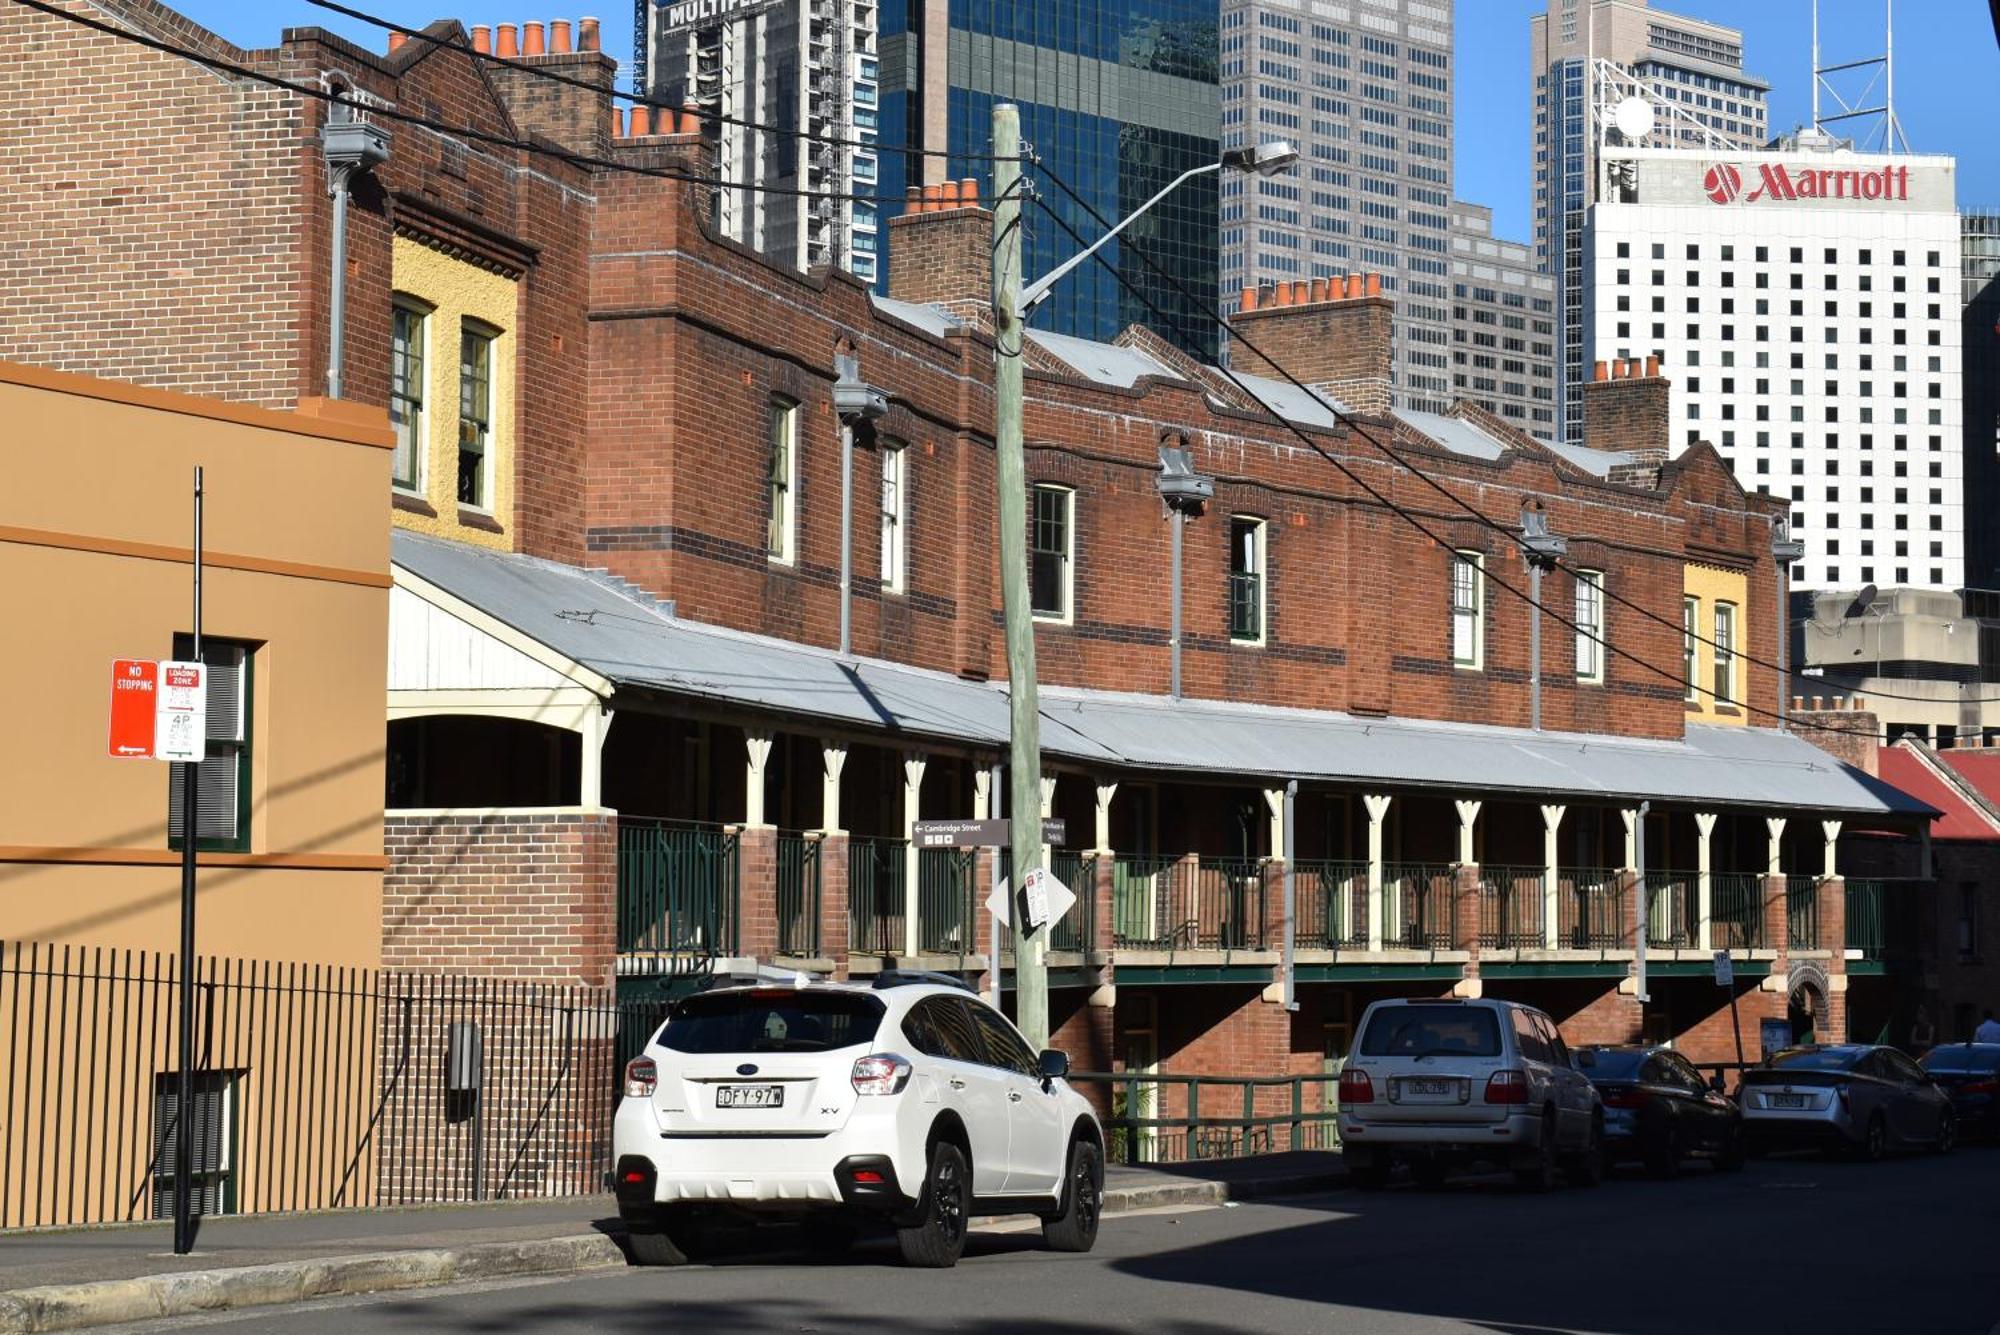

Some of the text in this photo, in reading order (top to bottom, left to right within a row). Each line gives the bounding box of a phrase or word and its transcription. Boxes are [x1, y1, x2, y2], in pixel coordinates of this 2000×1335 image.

[1746, 163, 1908, 202] Marriott
[129, 666, 142, 677] NO
[168, 669, 196, 677] LOADING
[117, 679, 153, 691] STOPPING
[172, 677, 193, 685] ZONE
[172, 714, 191, 724] 4P
[924, 823, 982, 833] Cambridge Street
[821, 1107, 839, 1115] XV
